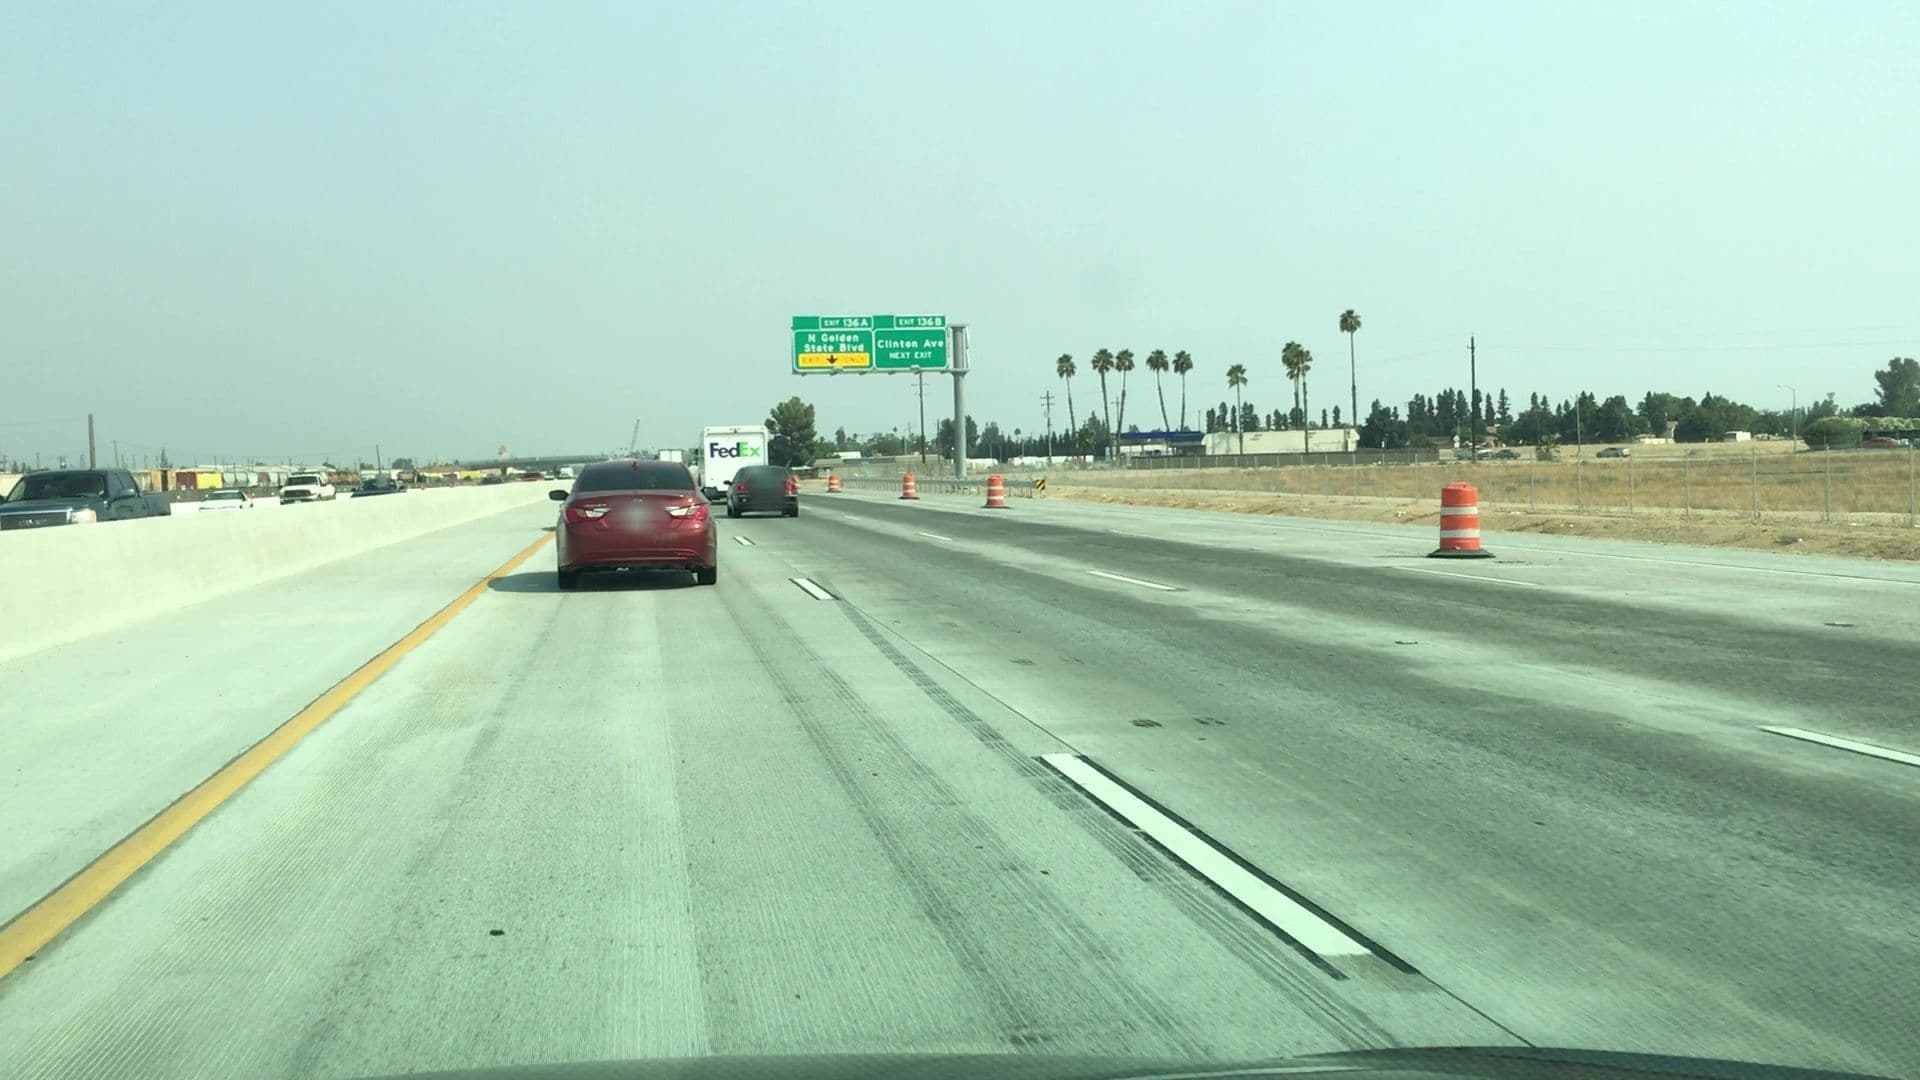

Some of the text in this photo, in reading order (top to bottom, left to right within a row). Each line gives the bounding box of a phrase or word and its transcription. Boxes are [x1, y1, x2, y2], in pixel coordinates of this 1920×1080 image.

[820, 334, 859, 342] Golden
[804, 343, 864, 352] State Blvd
[877, 340, 944, 348] Clinton Ave
[710, 442, 760, 458] FedEx
